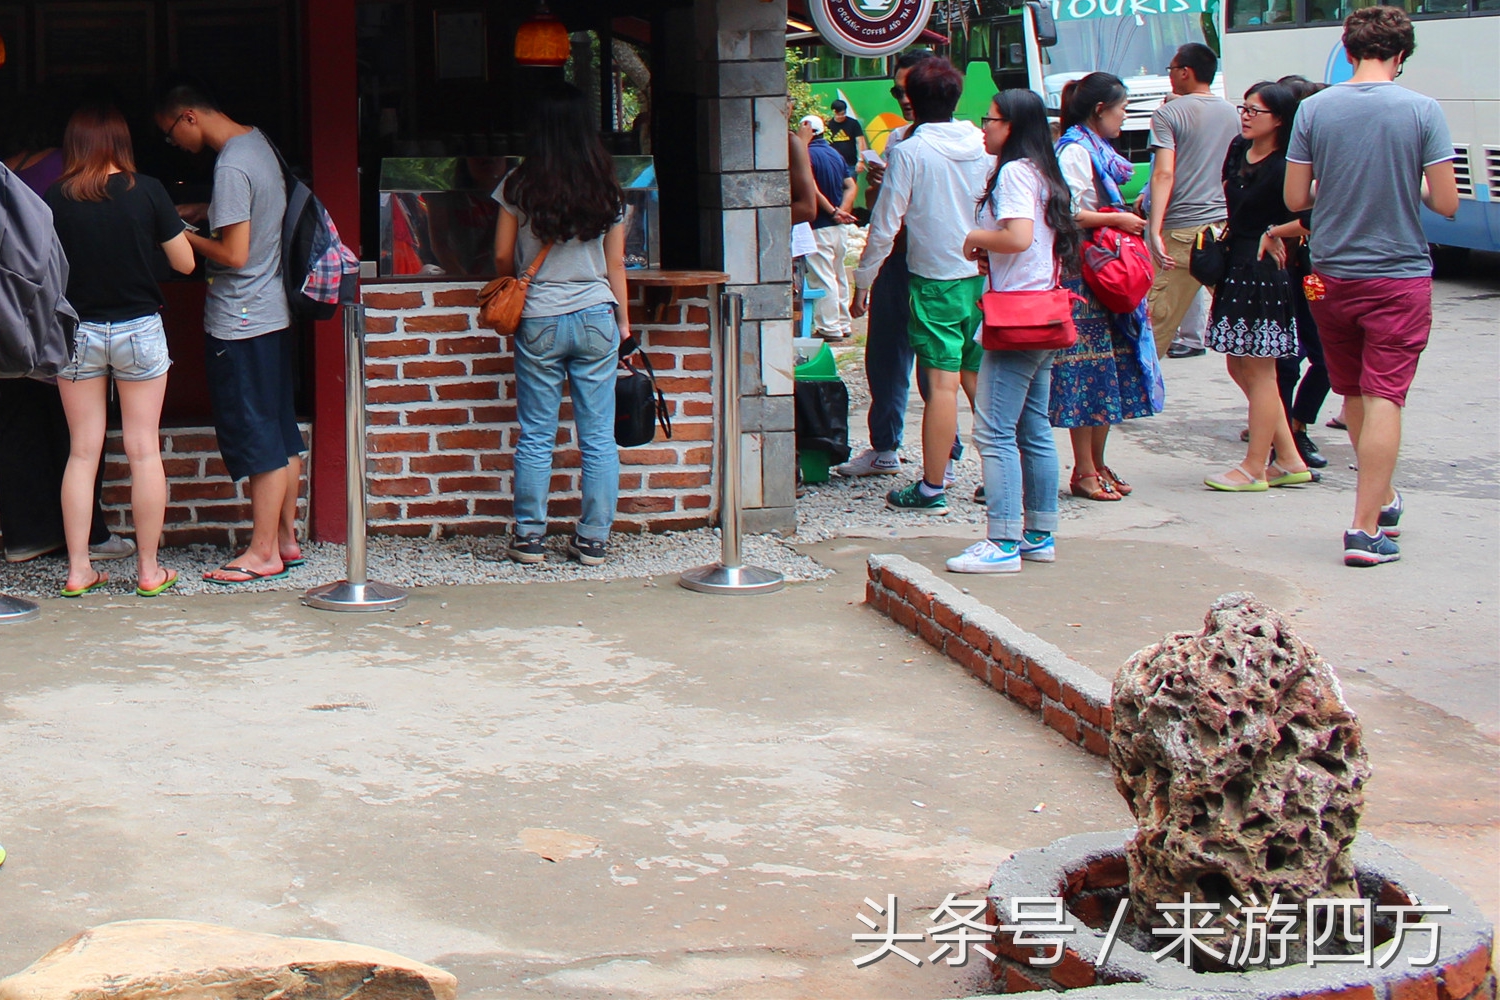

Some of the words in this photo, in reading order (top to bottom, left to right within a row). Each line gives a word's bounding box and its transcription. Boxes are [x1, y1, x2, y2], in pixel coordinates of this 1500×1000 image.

[837, 7, 860, 31] ORGANIC
[862, 27, 887, 36] COFFEE
[889, 19, 901, 31] AND
[900, 8, 911, 20] TEA
